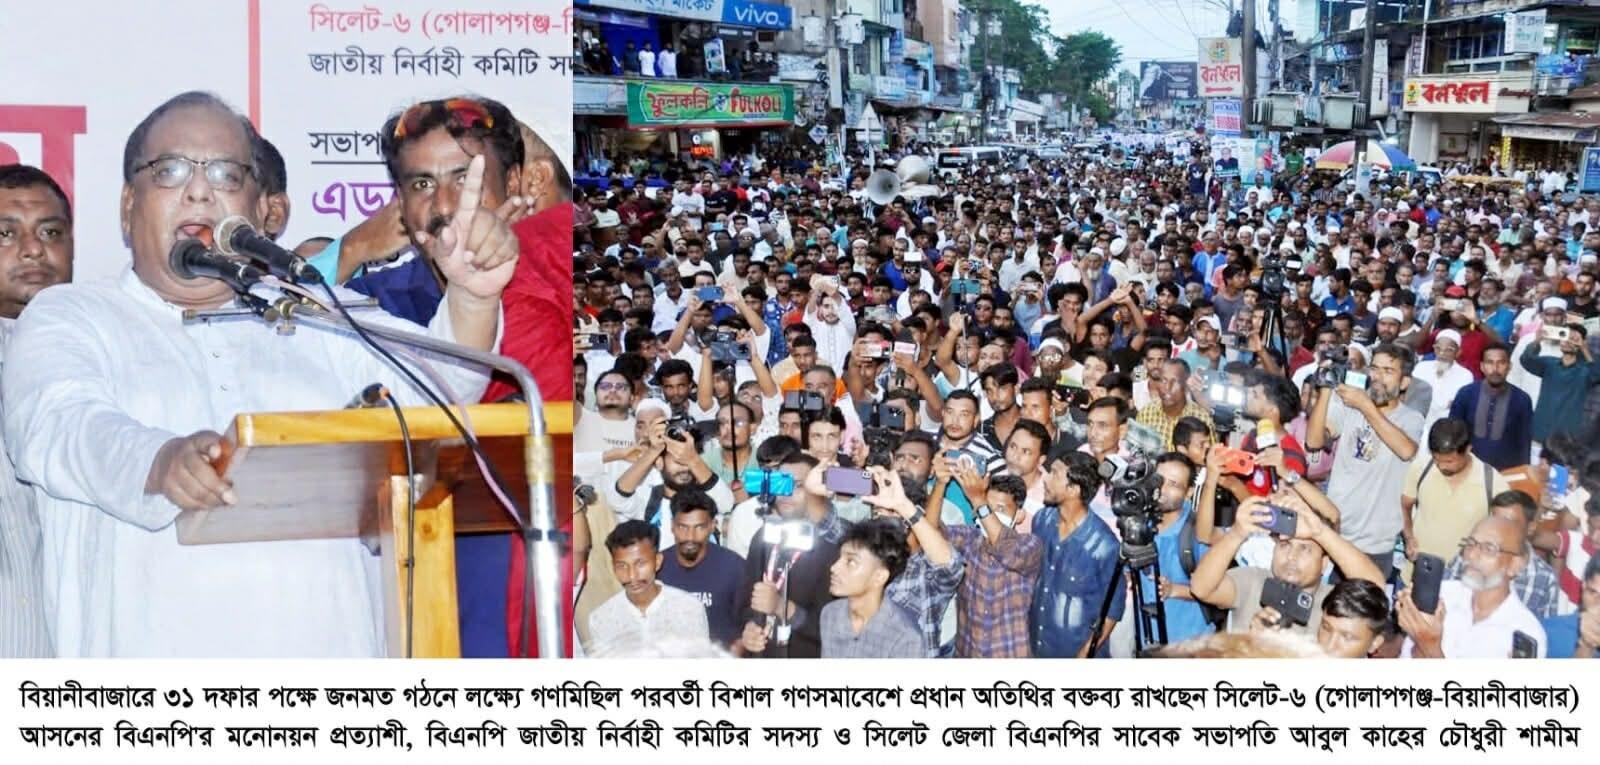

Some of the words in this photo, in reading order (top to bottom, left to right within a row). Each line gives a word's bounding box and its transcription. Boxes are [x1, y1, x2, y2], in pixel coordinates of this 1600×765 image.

[310, 4, 410, 33] সিলেট-৬
[734, 4, 779, 25] vivo
[308, 46, 384, 75] জাতীয়
[392, 47, 465, 78] নির্বাহী
[472, 48, 540, 76] কমিটি
[308, 130, 382, 156] সভাপ
[311, 182, 397, 221] এড
